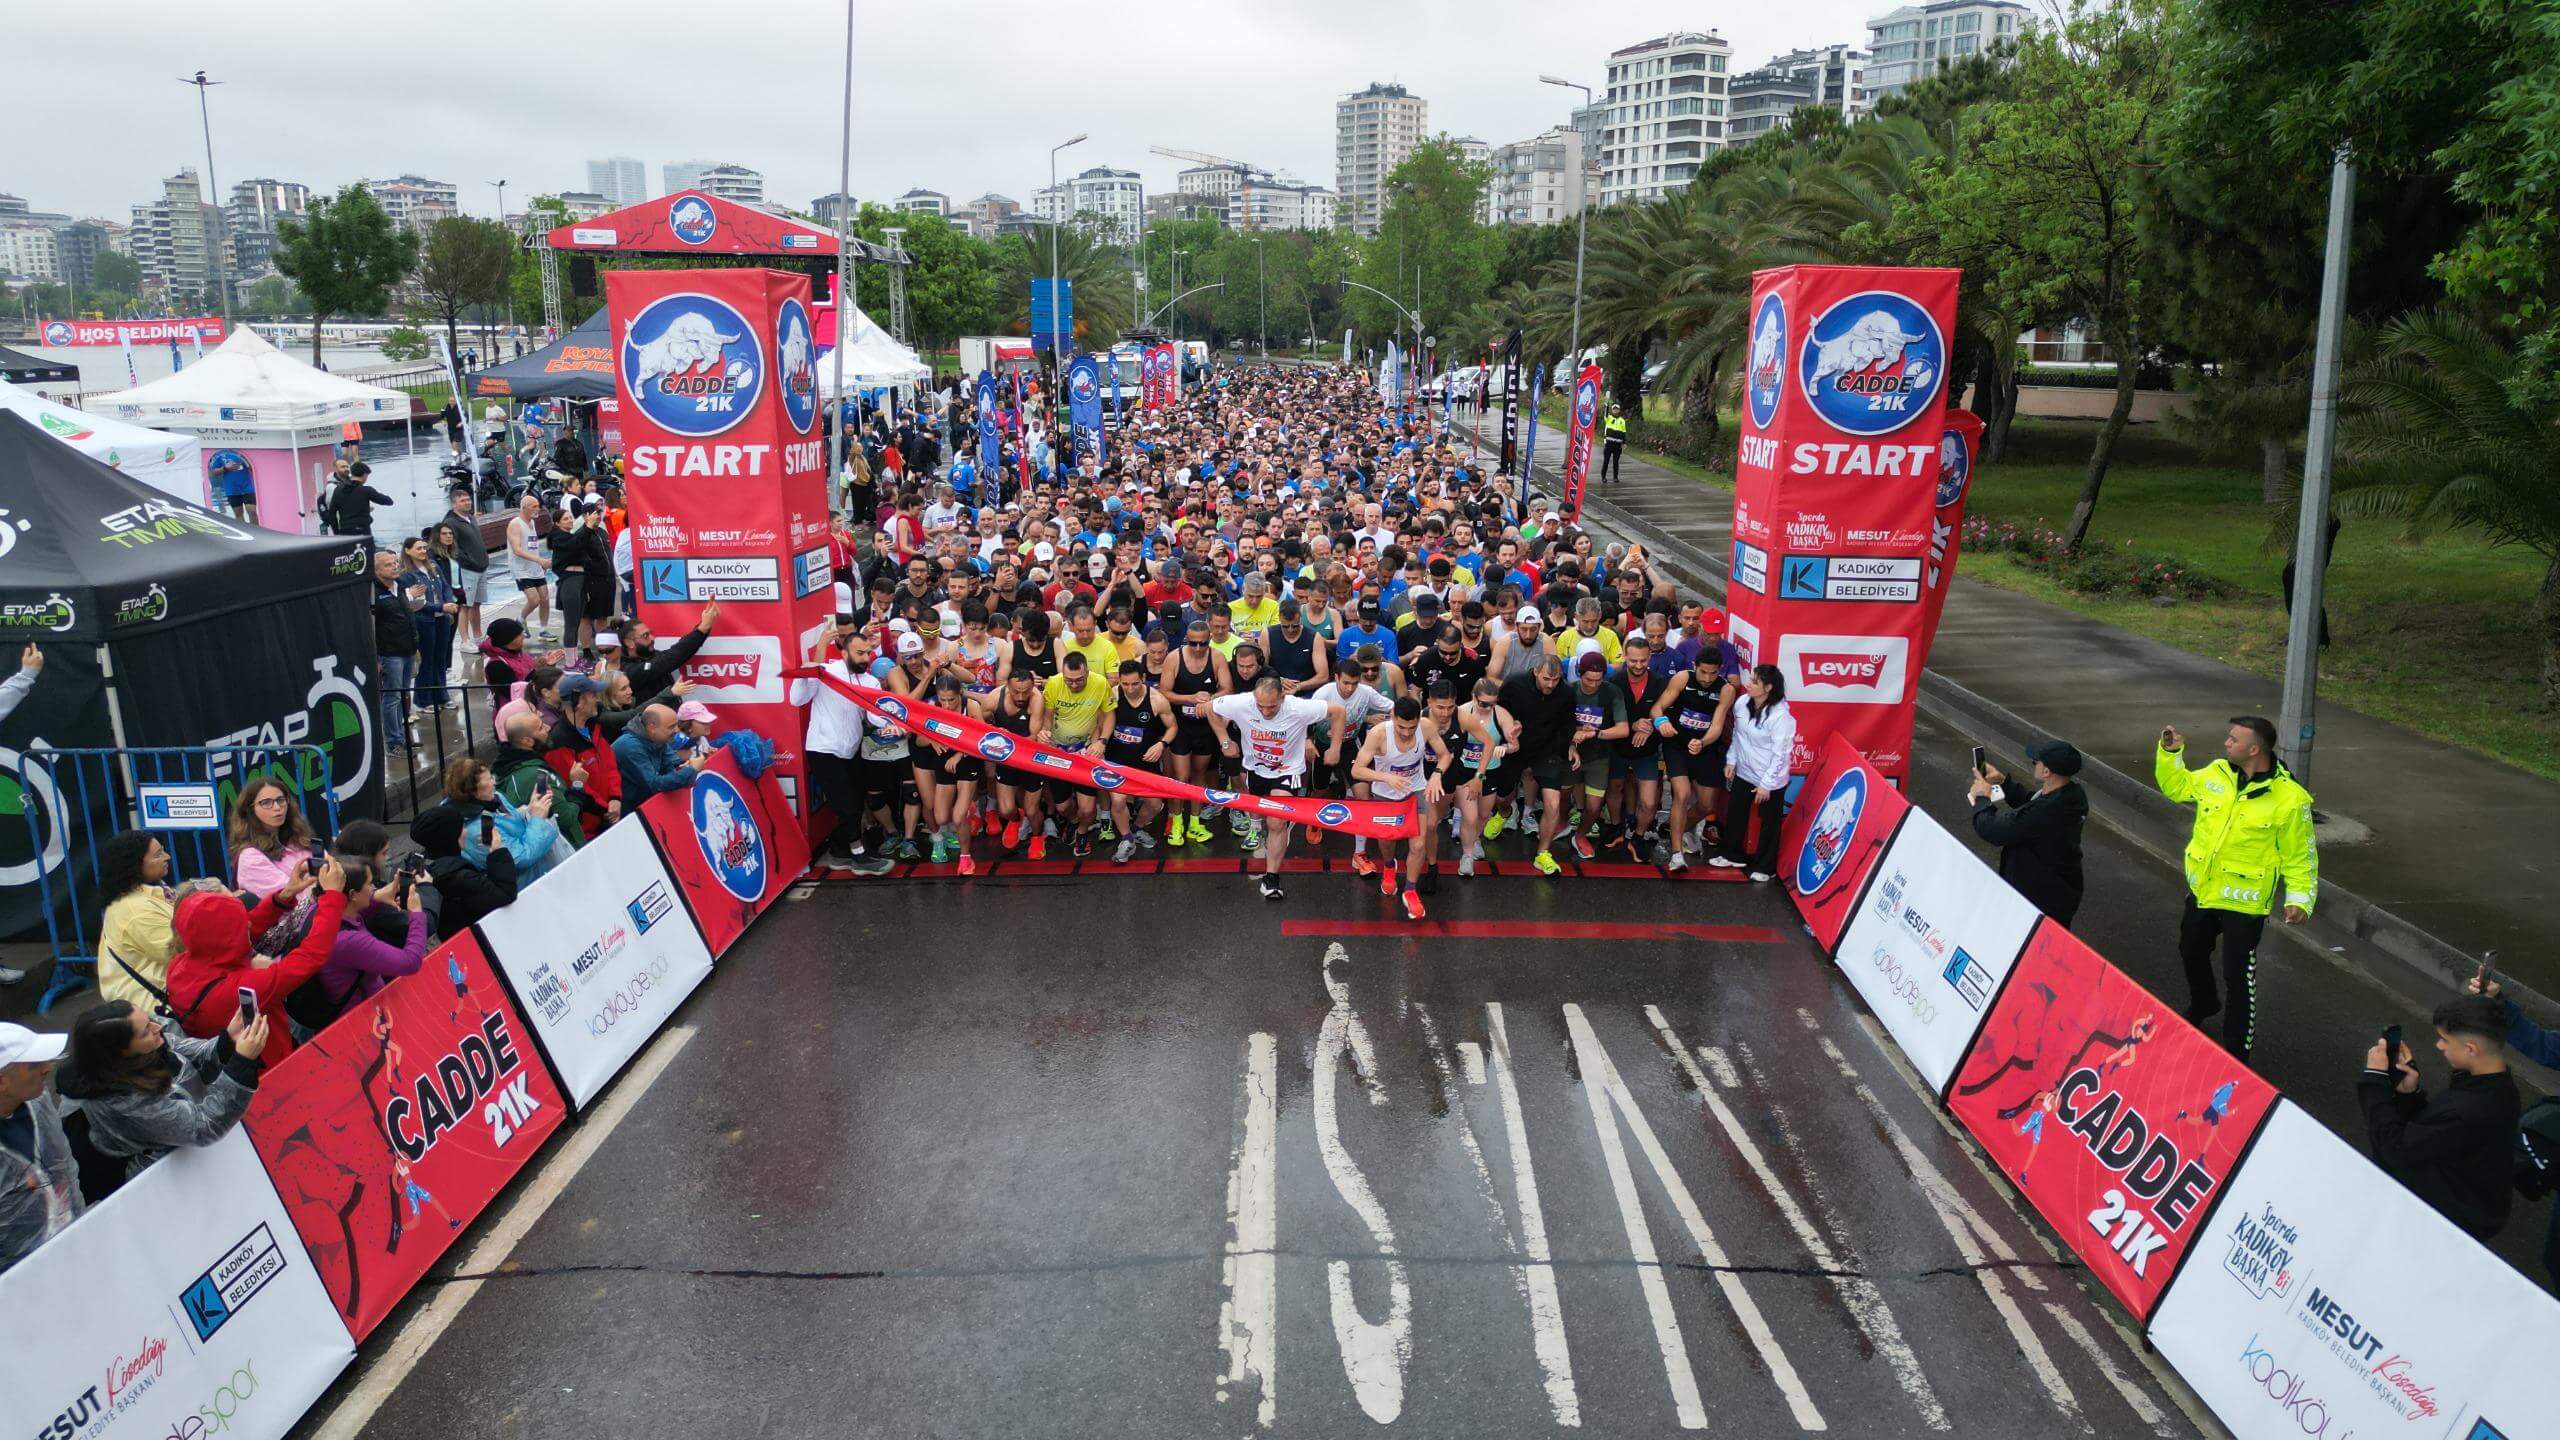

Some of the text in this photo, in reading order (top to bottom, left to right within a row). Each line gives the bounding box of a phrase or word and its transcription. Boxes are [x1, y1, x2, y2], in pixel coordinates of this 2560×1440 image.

[131, 324, 194, 339] ELDİNİZ
[660, 376, 736, 394] CADDE
[1836, 375, 1917, 394] CADDE
[695, 396, 735, 412] 21K
[1868, 395, 1908, 411] 21K
[632, 445, 770, 476] START
[785, 440, 822, 475] START
[1568, 426, 1585, 503] ADDE
[1741, 435, 1779, 470] START
[1791, 443, 1935, 476] START
[699, 530, 742, 540] MESUT
[1847, 530, 1890, 540] MESUT
[330, 562, 360, 575] TIMING
[334, 554, 355, 566] ETAP
[697, 562, 751, 575] KADIKÖY
[1838, 562, 1894, 575] KADIKÖY
[121, 597, 150, 611] ETAP
[699, 583, 770, 596] BELEDİYESİ
[1835, 584, 1909, 597] BELEDİYESİ
[3, 605, 47, 615] ETAP
[115, 607, 157, 623] TIMING
[206, 710, 309, 780] ETAP
[724, 836, 753, 870] CADDE
[1903, 905, 1931, 937] MESUT
[572, 942, 603, 976] MESUT
[386, 1009, 520, 1164] CADDE
[484, 1070, 541, 1148] 21K
[2055, 1067, 2216, 1233] CADDE
[2087, 1189, 2168, 1278] 21K
[2261, 1200, 2299, 1246] Sporda
[2234, 1211, 2295, 1275] KADIKÖY
[218, 1244, 255, 1281] KADIKÖY
[229, 1254, 277, 1303] BELEDİYESİ
[2231, 1246, 2269, 1289] BAŞKA
[2306, 1286, 2384, 1361] MESUT
[2297, 1310, 2332, 1346] KADIKÖY
[2369, 1377, 2407, 1417] BAŞKANI
[116, 1373, 157, 1413] BAŞKANI
